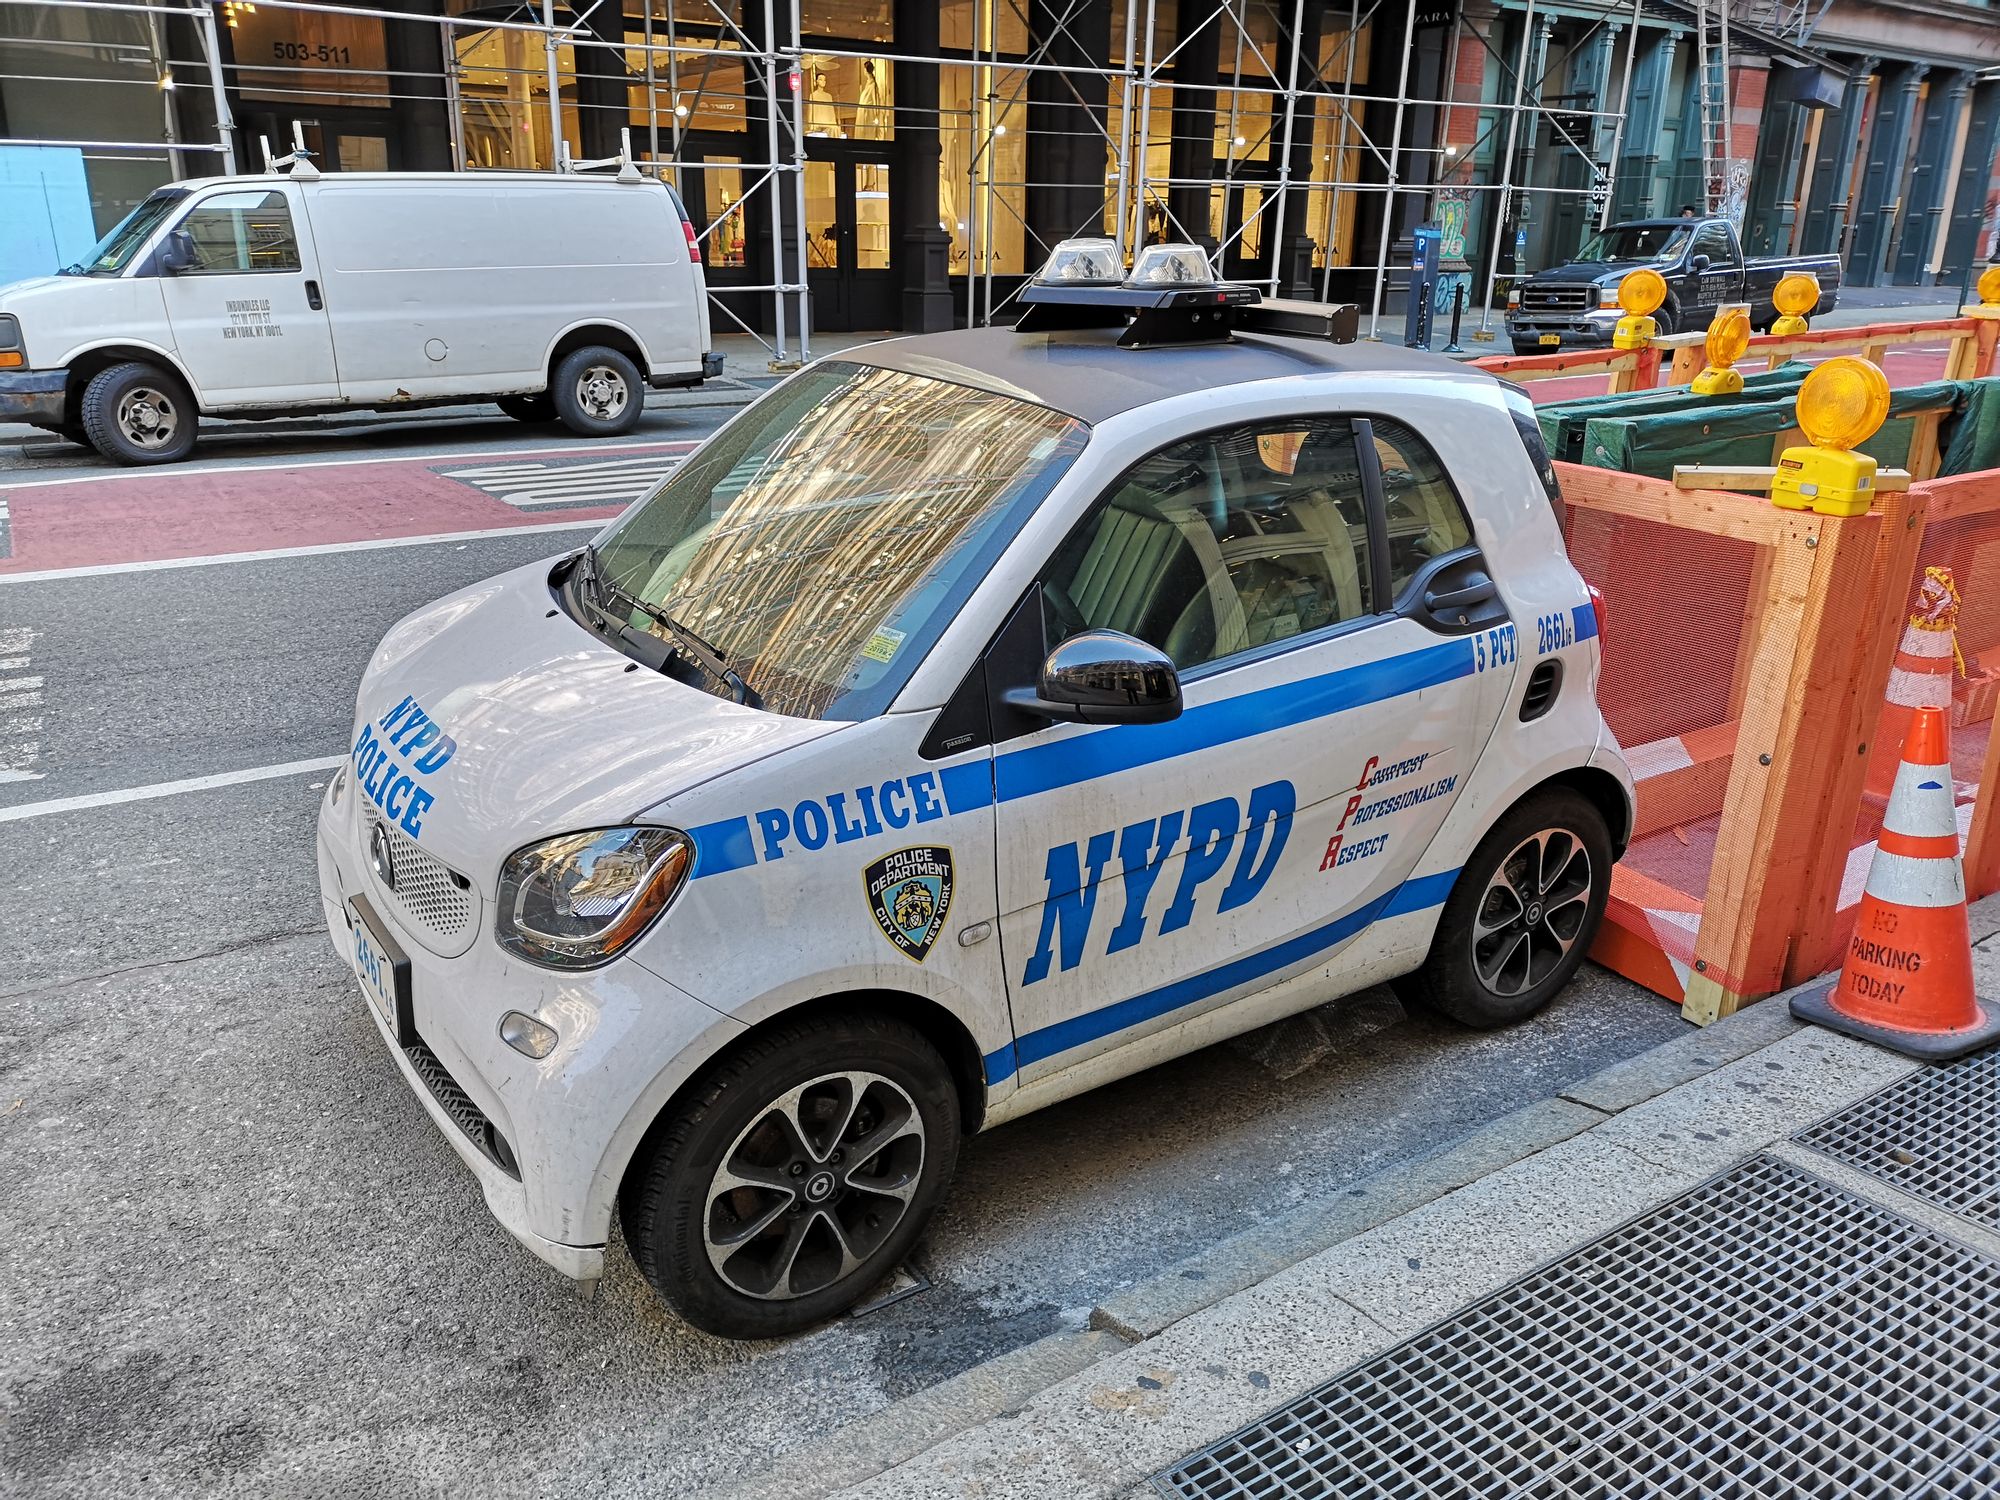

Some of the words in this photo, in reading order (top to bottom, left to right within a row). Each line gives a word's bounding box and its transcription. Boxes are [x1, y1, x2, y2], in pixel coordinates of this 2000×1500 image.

[273, 42, 350, 64] 503-511
[958, 250, 1001, 260] ZA
[1418, 238, 1426, 251] P
[260, 299, 270, 311] LLC
[222, 326, 237, 339] NEW
[255, 325, 263, 337] NY
[1475, 634, 1486, 673] 5
[1488, 624, 1516, 668] PCT
[378, 695, 457, 775] NYPD
[352, 723, 435, 840] POLICE
[755, 771, 943, 862] POLICE
[885, 849, 933, 872] POLICE
[871, 862, 950, 897] DEPARTMENT
[1021, 779, 1297, 988] NYPD
[875, 907, 896, 935] CITY
[894, 934, 911, 949] OF
[923, 917, 942, 946] NEW
[937, 882, 951, 914] YORK
[1873, 908, 1898, 934] NO
[355, 928, 384, 998] 2661
[1851, 935, 1921, 972] PARKING
[1851, 970, 1905, 1004] TODAY
